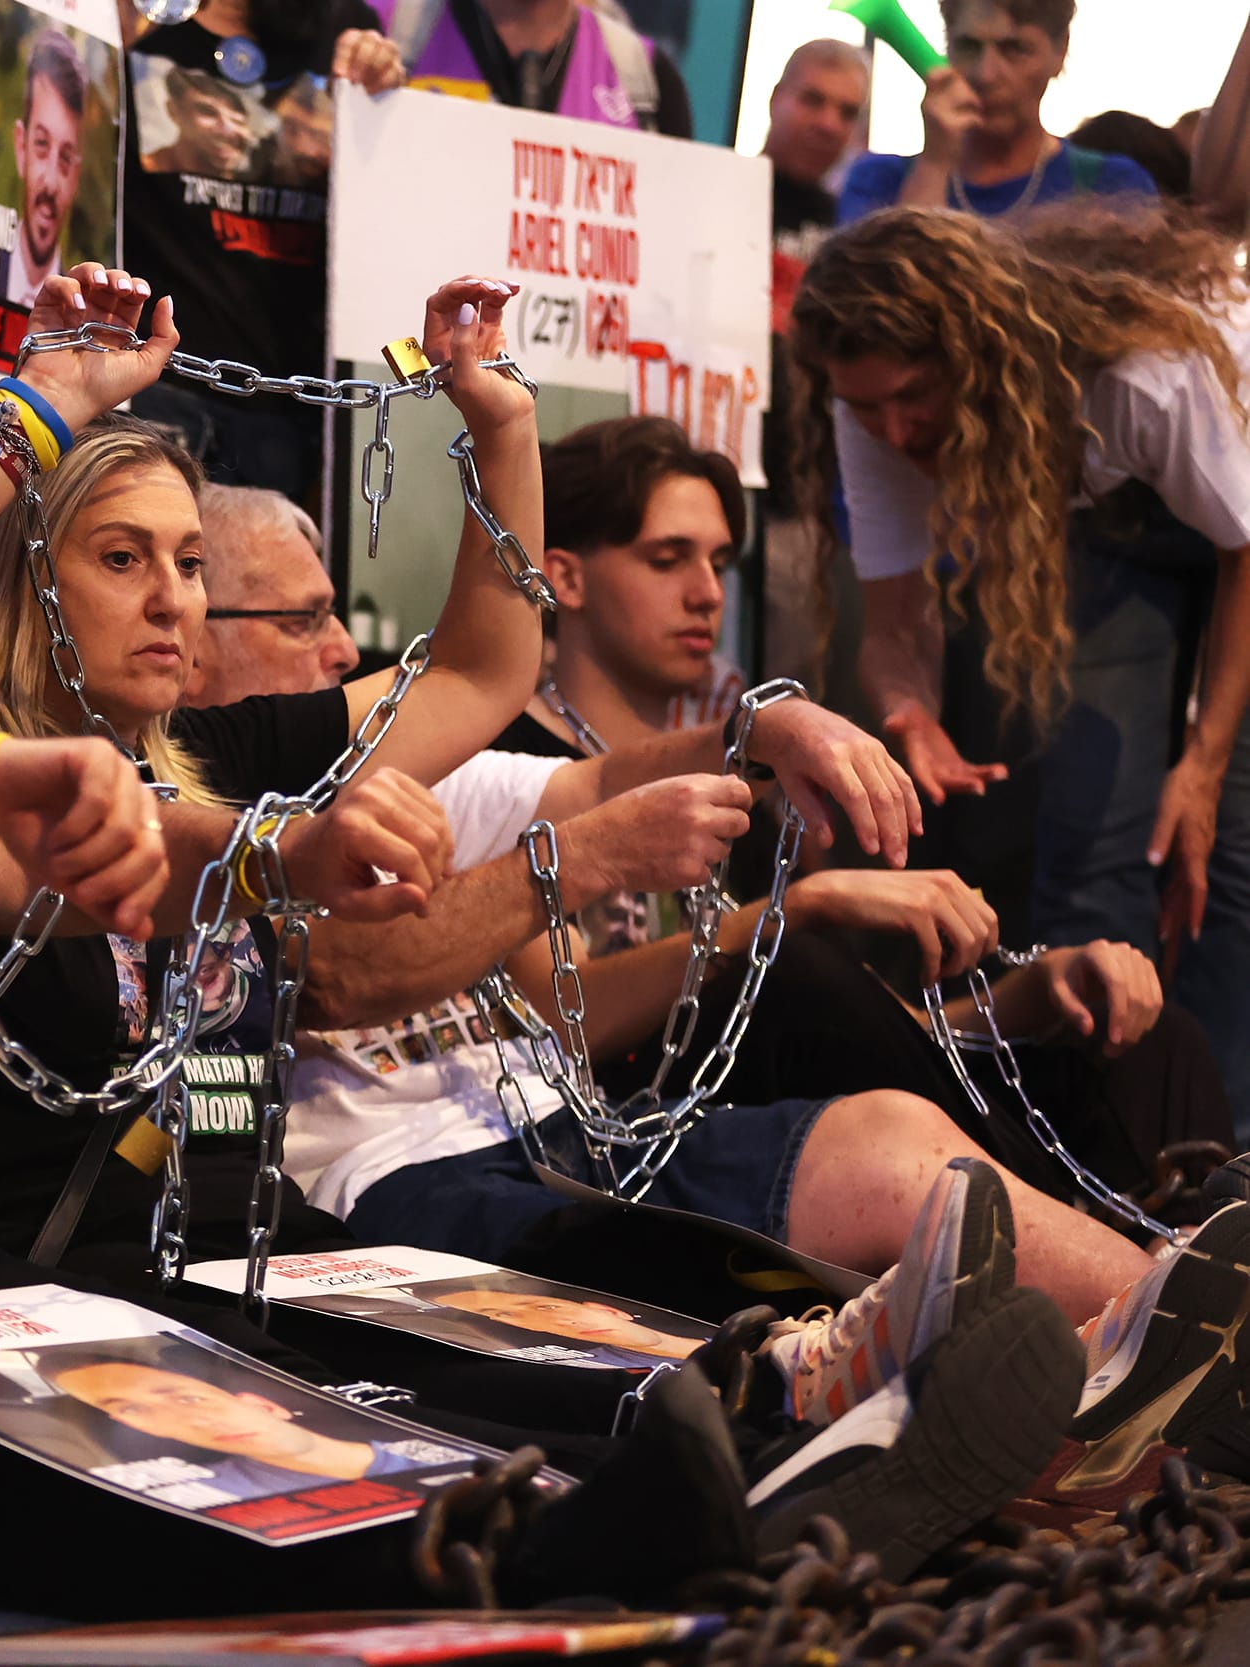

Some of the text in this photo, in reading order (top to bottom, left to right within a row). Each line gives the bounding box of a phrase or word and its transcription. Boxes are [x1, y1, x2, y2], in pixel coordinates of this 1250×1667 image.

[508, 211, 640, 288] ARIEL CUNIO
[183, 1057, 245, 1083] MATAN
[190, 1094, 254, 1131] NOW!
